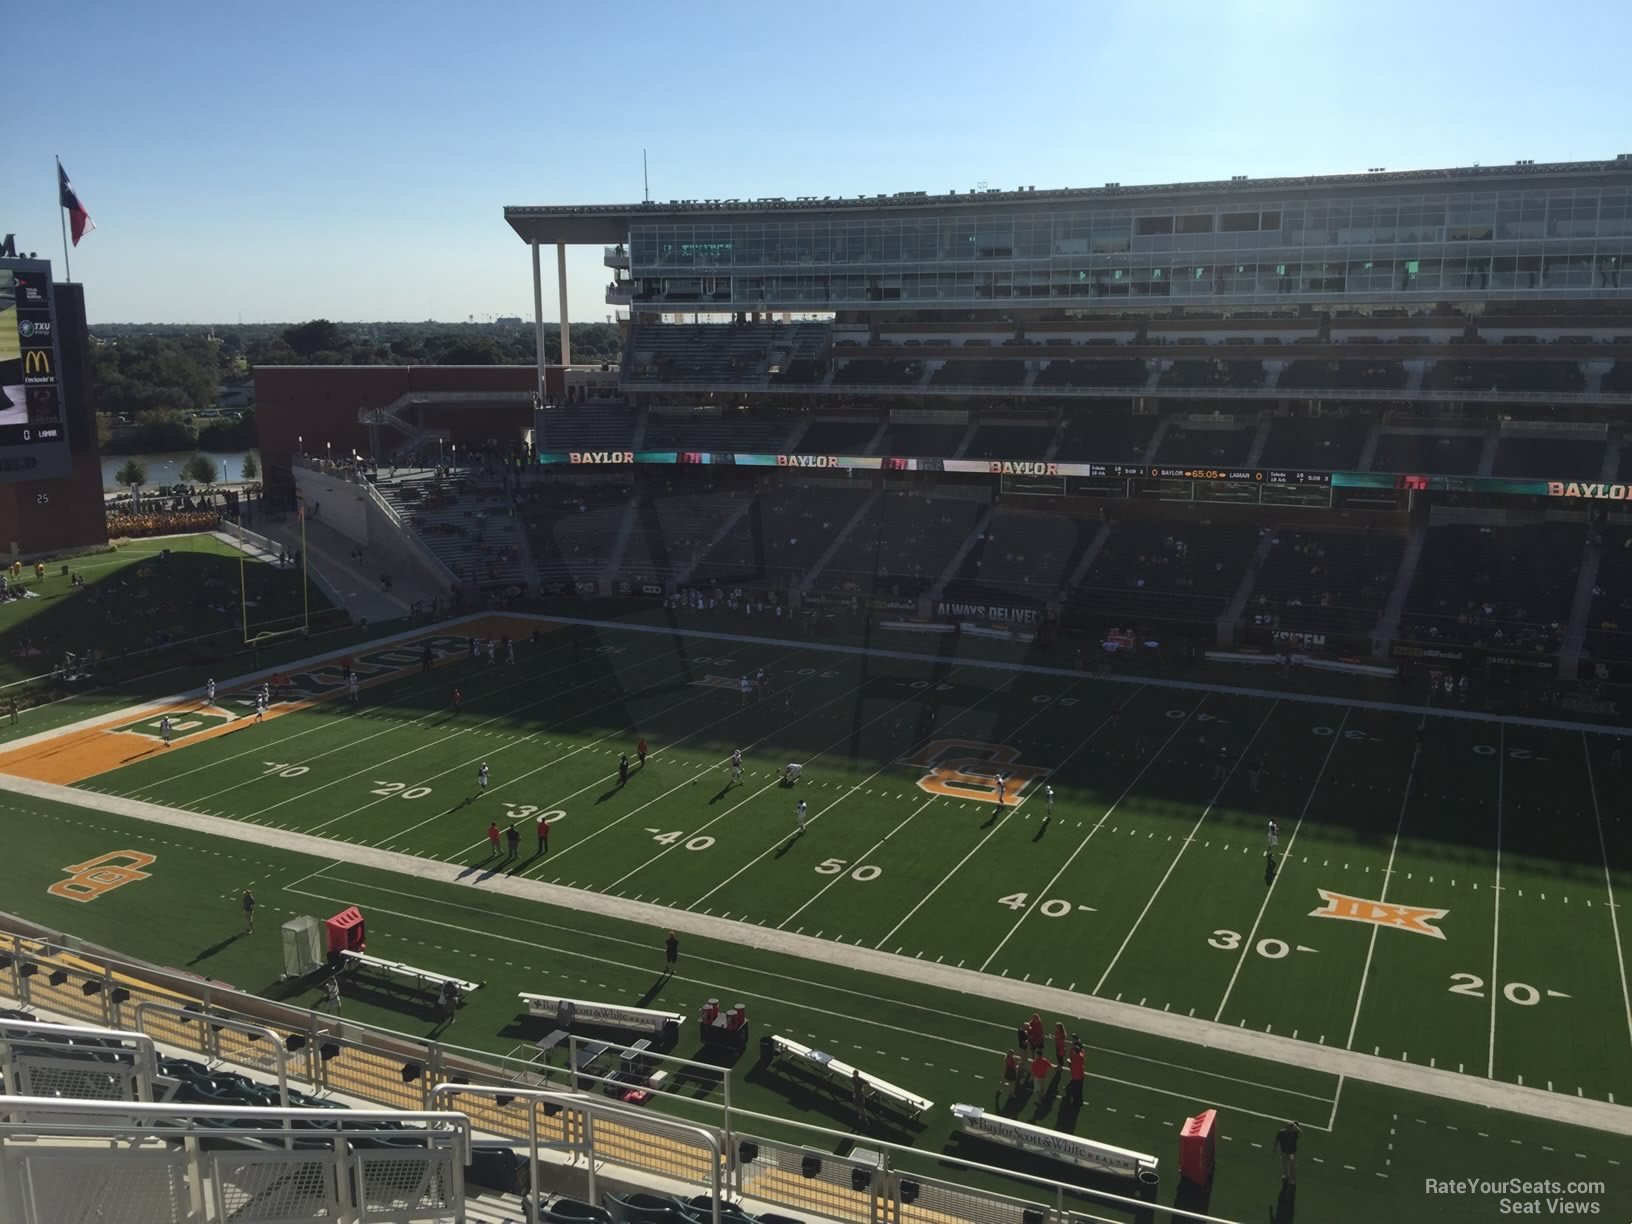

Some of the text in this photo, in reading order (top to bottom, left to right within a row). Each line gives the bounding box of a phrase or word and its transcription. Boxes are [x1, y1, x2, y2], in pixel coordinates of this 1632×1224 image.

[34, 322, 51, 331] TXU
[23, 429, 57, 441] 0 LAMAR
[569, 452, 634, 464] BAYLOR
[776, 455, 839, 468] BAYLOR
[989, 461, 1059, 476] BAYLOR
[1151, 469, 1158, 477] 0
[1161, 469, 1184, 477] BAYLOR
[1192, 470, 1218, 479] 65:05
[1255, 472, 1263, 481] 0
[37, 494, 49, 503] 25
[938, 602, 985, 618] ALWAYS
[263, 763, 309, 778] 10
[371, 782, 432, 800] 20
[506, 804, 567, 825] 30
[653, 830, 716, 851] 40
[814, 858, 882, 881] 50
[997, 892, 1072, 917] 40
[1207, 929, 1290, 959] 30
[1448, 972, 1540, 1006] 20
[1087, 1153, 1130, 1168] HEALTH
